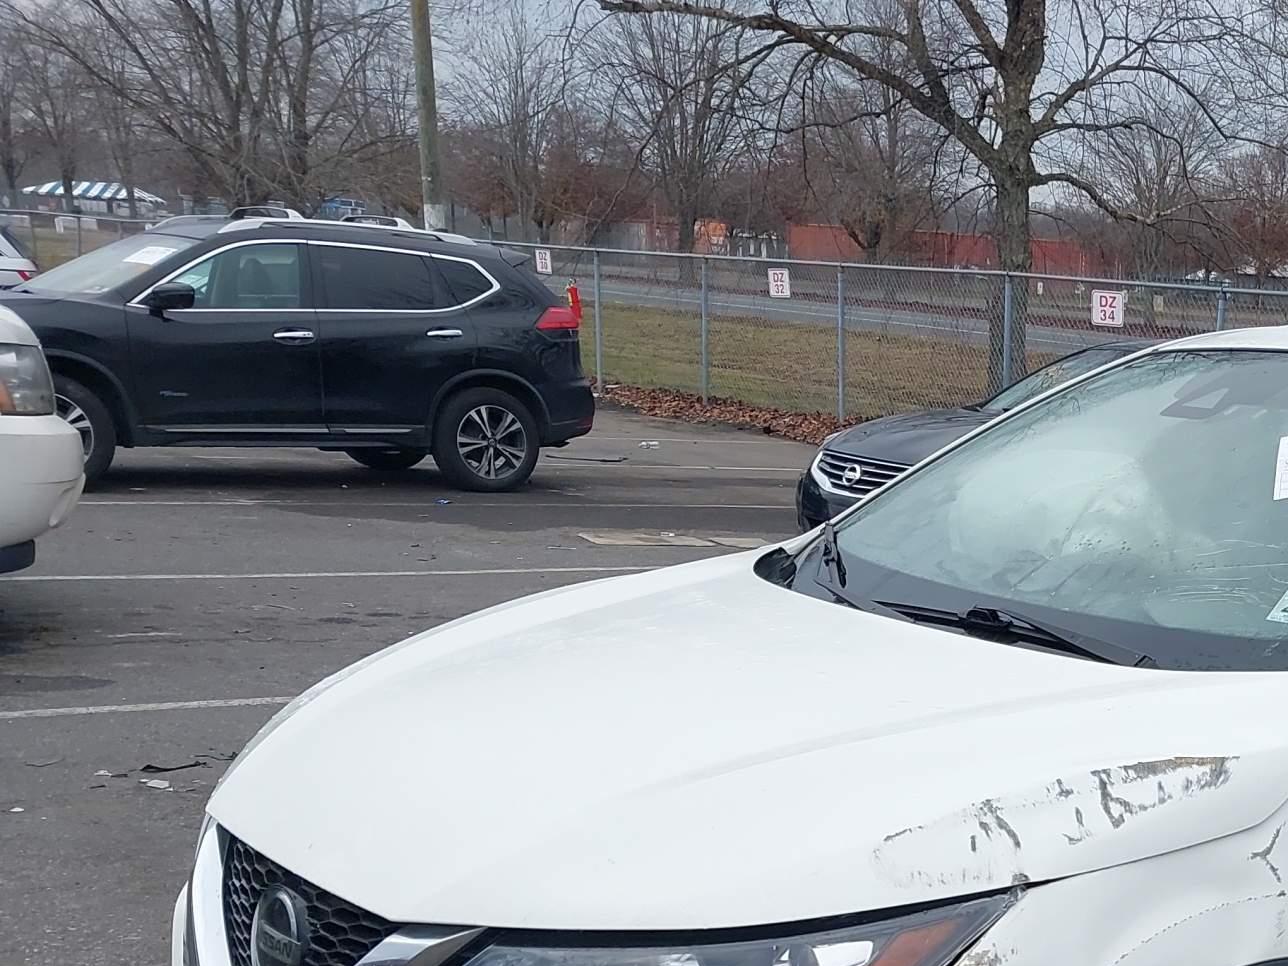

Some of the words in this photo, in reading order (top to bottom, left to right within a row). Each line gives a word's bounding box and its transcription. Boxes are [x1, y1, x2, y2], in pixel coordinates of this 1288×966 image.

[773, 272, 785, 283] DZ
[774, 283, 785, 294] 32
[1099, 295, 1117, 309] DZ
[1100, 309, 1116, 322] 34
